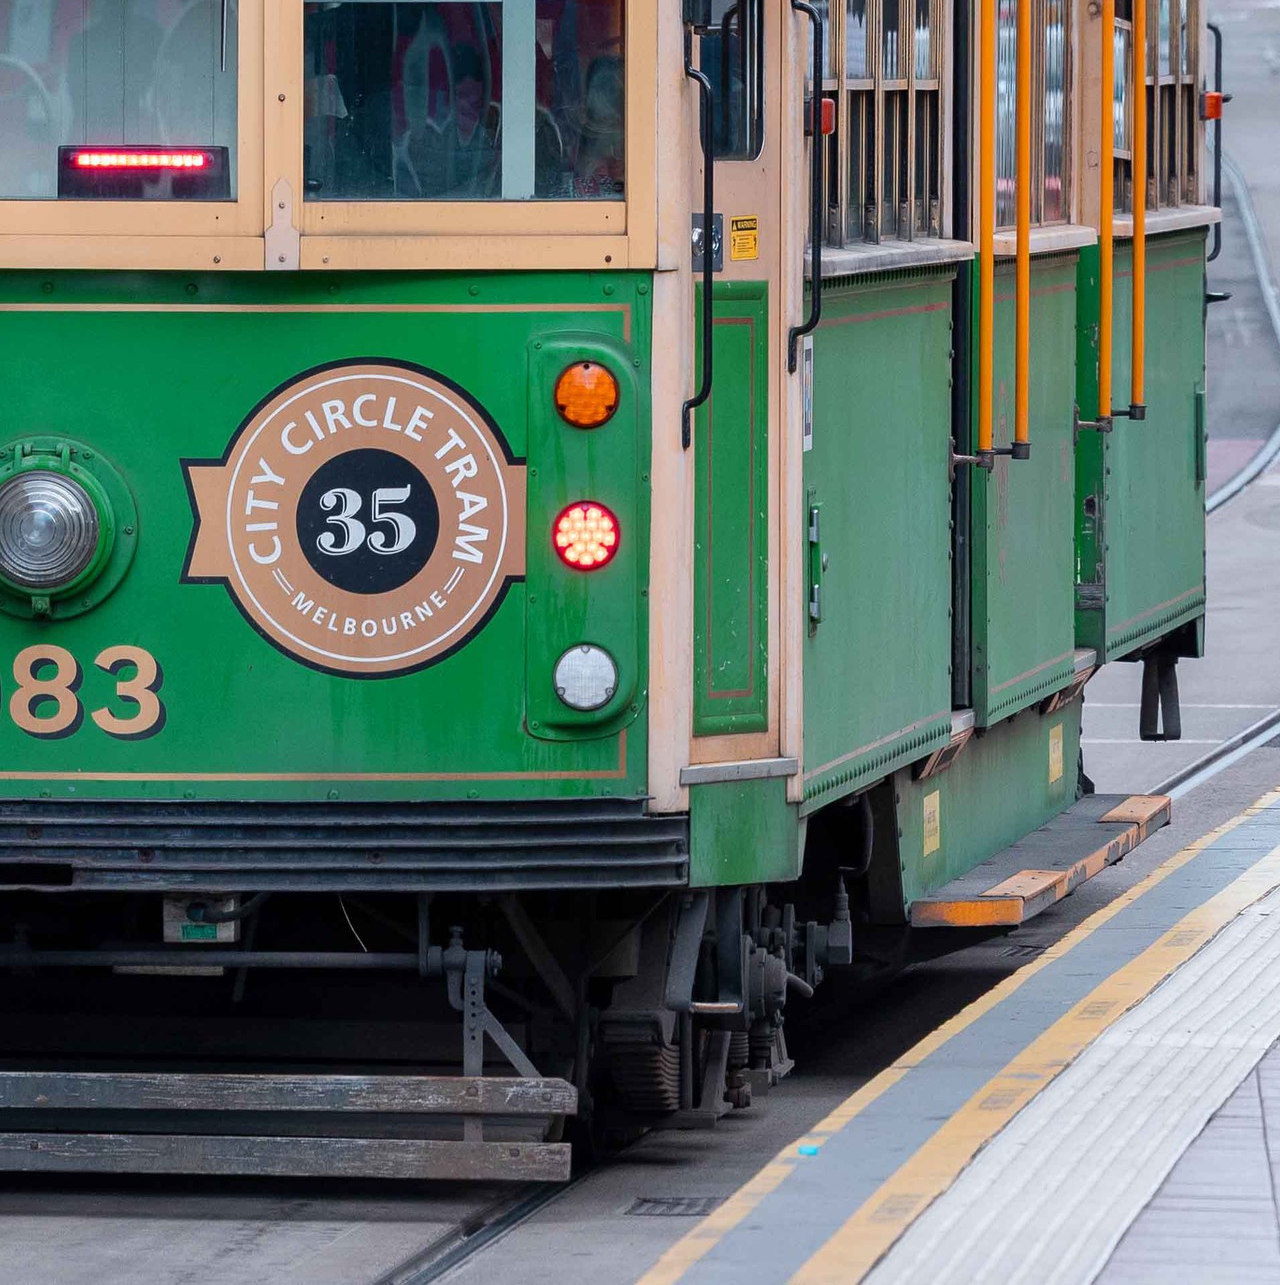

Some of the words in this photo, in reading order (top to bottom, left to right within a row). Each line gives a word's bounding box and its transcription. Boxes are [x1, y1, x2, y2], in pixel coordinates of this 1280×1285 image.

[243, 456, 286, 567] CITY
[280, 392, 434, 456] CIRCLE
[433, 427, 490, 565] TRAM
[317, 484, 417, 555] 35
[291, 589, 448, 638] MELBOURNE
